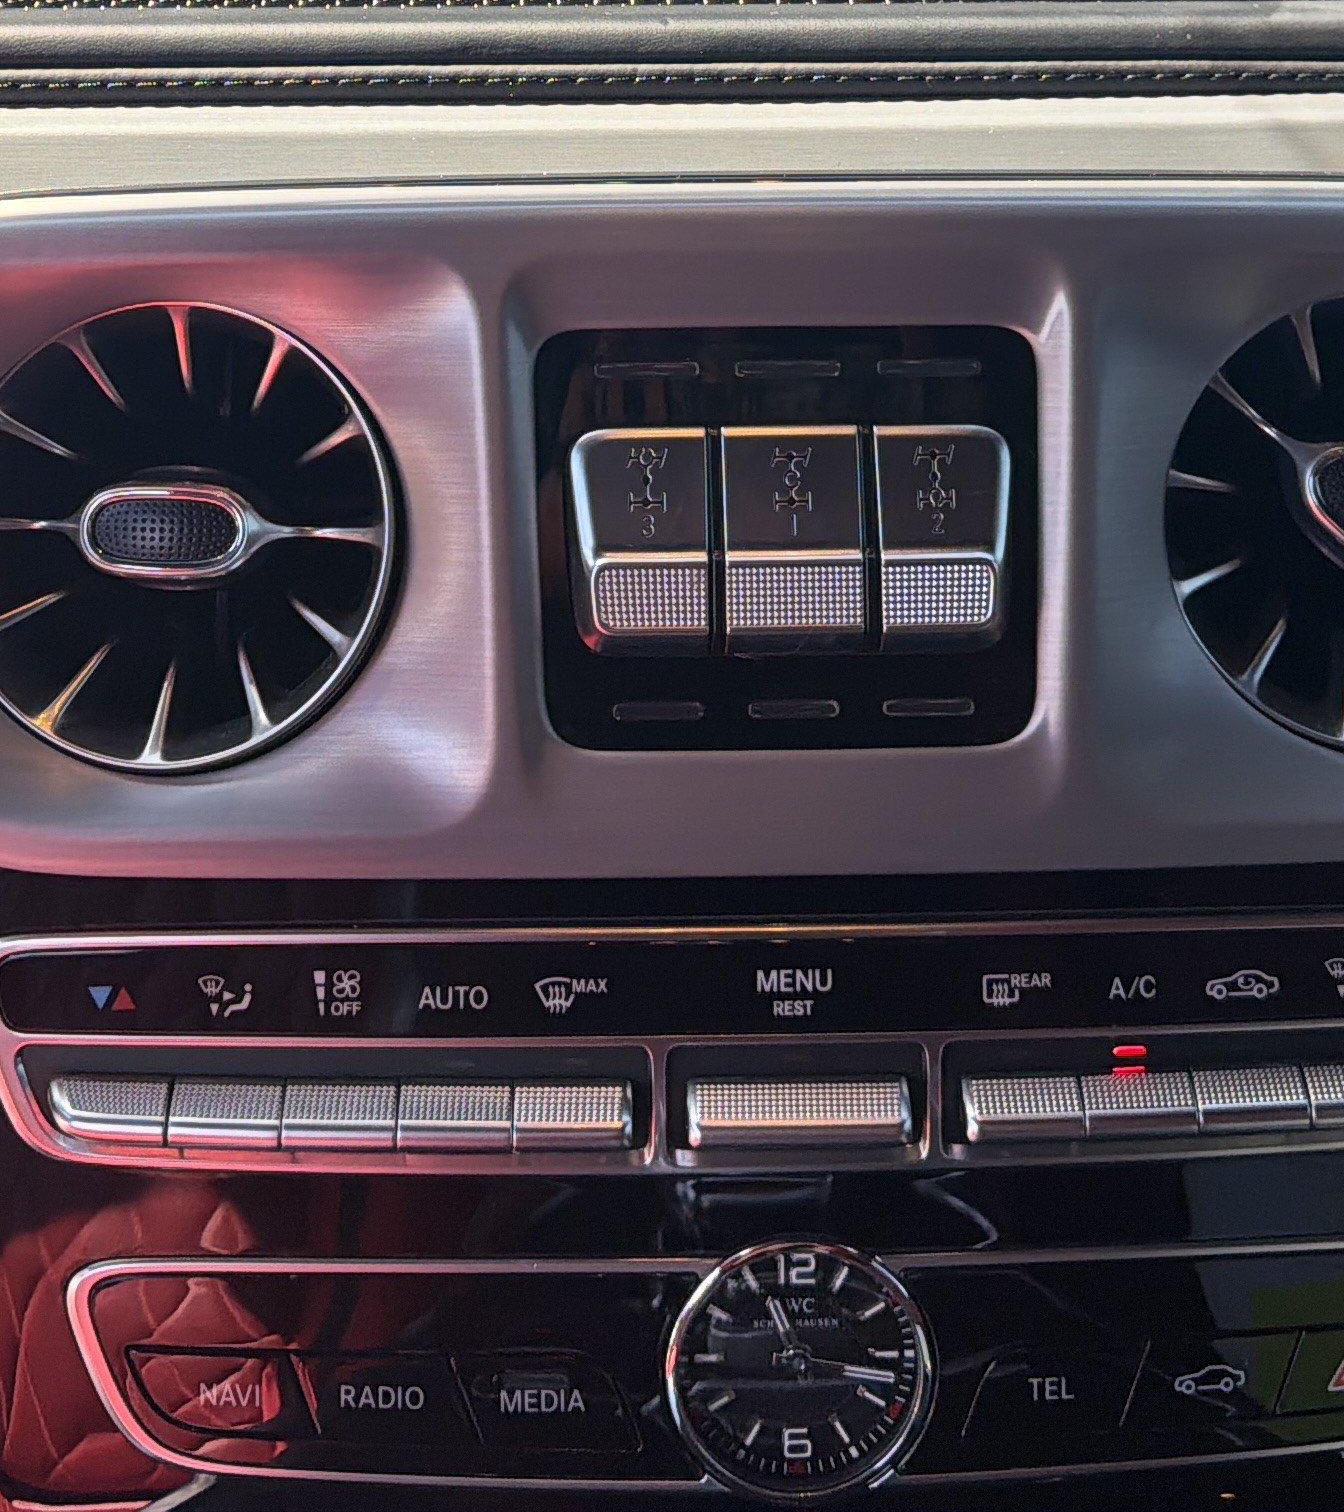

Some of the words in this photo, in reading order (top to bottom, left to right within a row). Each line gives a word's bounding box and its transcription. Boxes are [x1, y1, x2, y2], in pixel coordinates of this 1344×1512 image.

[642, 515, 655, 537] 3
[791, 514, 798, 536] 1
[932, 512, 945, 534] 2
[572, 978, 608, 994] MAX
[756, 969, 833, 994] MENU
[1010, 973, 1051, 990] REAR
[1109, 975, 1156, 1001] A/C
[331, 1001, 361, 1017] OFF
[418, 985, 489, 1011] AUTO
[773, 1001, 814, 1017] REST
[777, 1253, 816, 1285] 12
[778, 1298, 815, 1313] WC
[199, 1383, 261, 1408] NAVI
[340, 1385, 424, 1411] RADIO
[1028, 1376, 1075, 1401] TEL
[499, 1389, 586, 1413] MEDIA
[783, 1427, 812, 1458] 6
